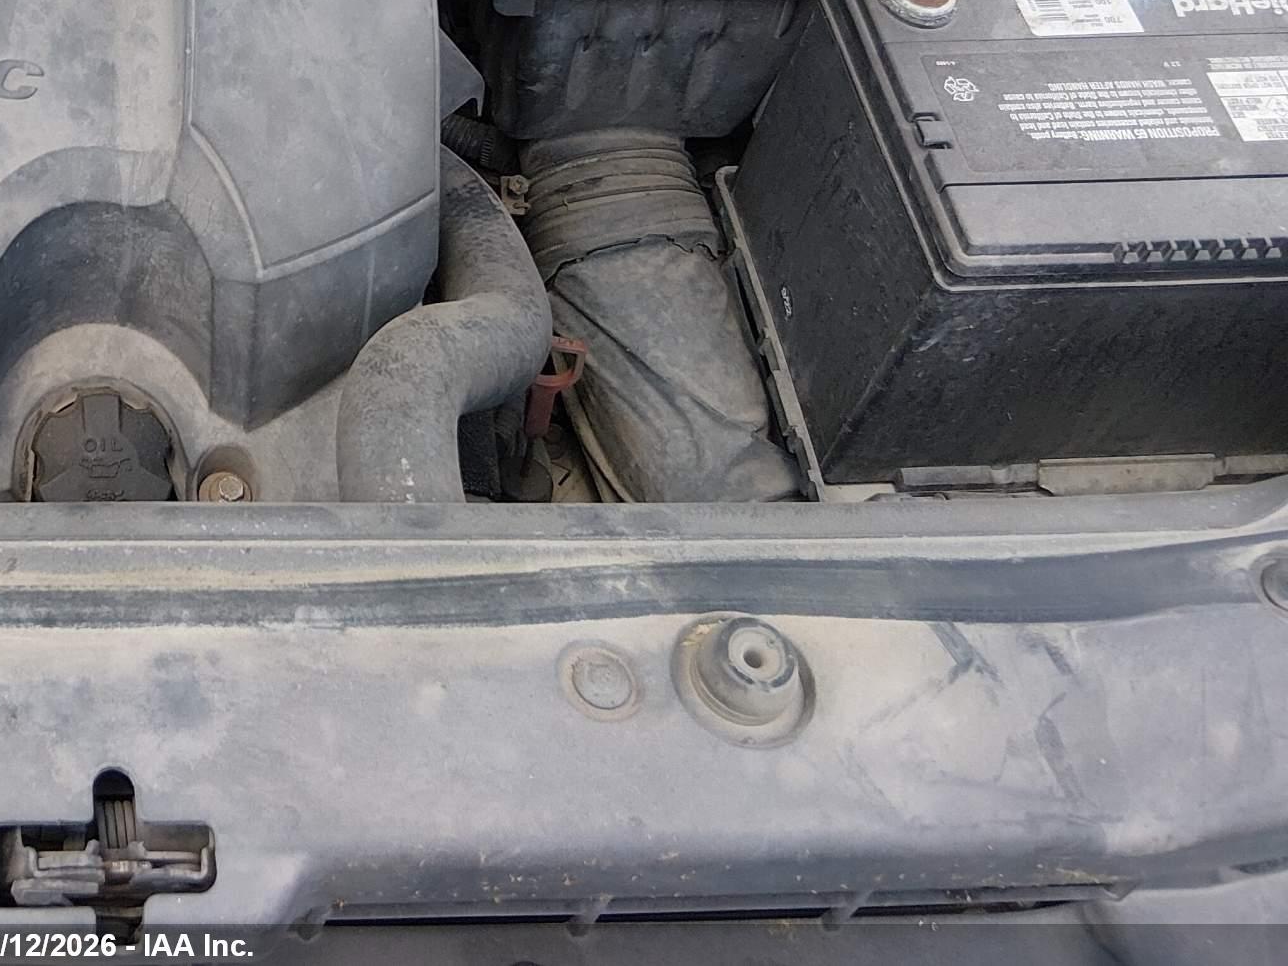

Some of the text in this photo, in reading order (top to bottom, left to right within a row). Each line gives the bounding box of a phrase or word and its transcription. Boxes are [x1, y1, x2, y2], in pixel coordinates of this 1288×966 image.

[1088, 82, 1114, 90] AFTER
[1018, 112, 1054, 122] California
[1078, 129, 1136, 141] WARNING:
[1147, 126, 1220, 138] PROPOSITION
[83, 437, 124, 453] OIL
